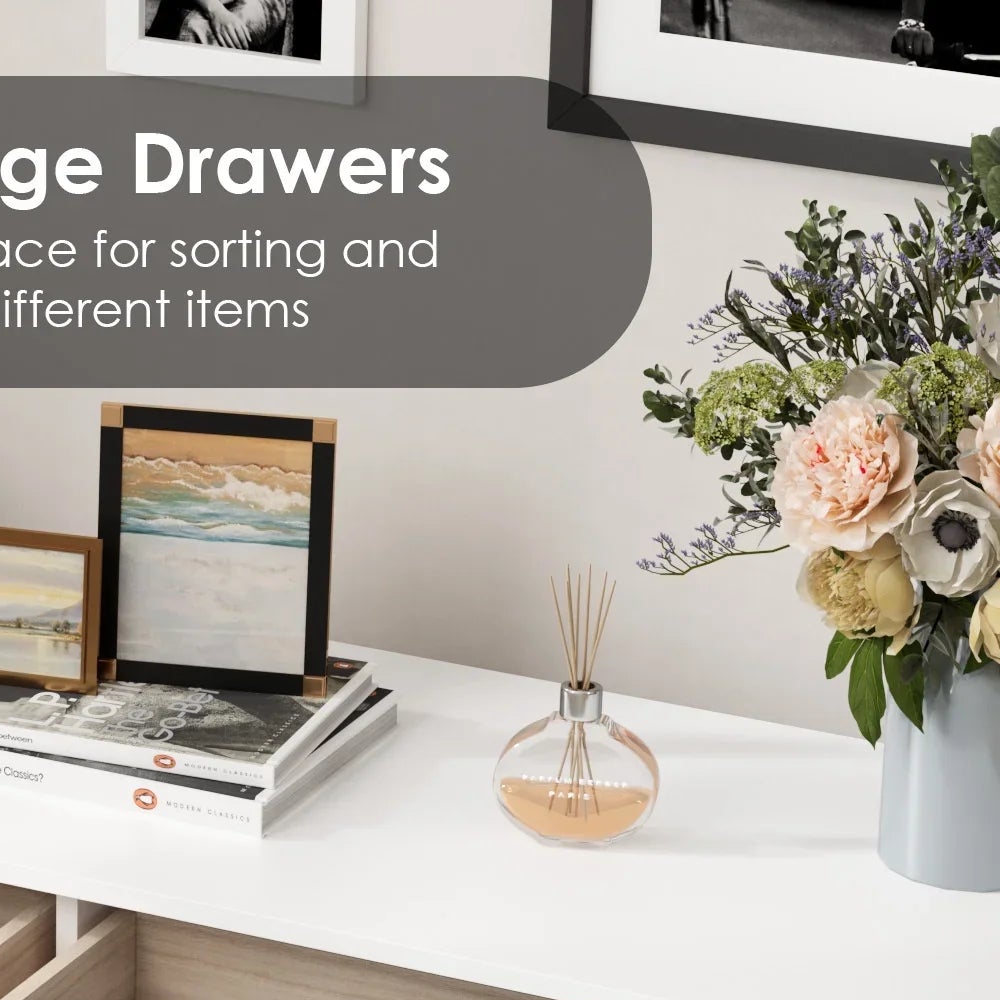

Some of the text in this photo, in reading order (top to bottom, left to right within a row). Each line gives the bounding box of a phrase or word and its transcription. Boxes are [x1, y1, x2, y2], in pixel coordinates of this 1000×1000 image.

[3, 766, 44, 784] Classics?
[166, 800, 251, 823] MODERN CLASSICS
